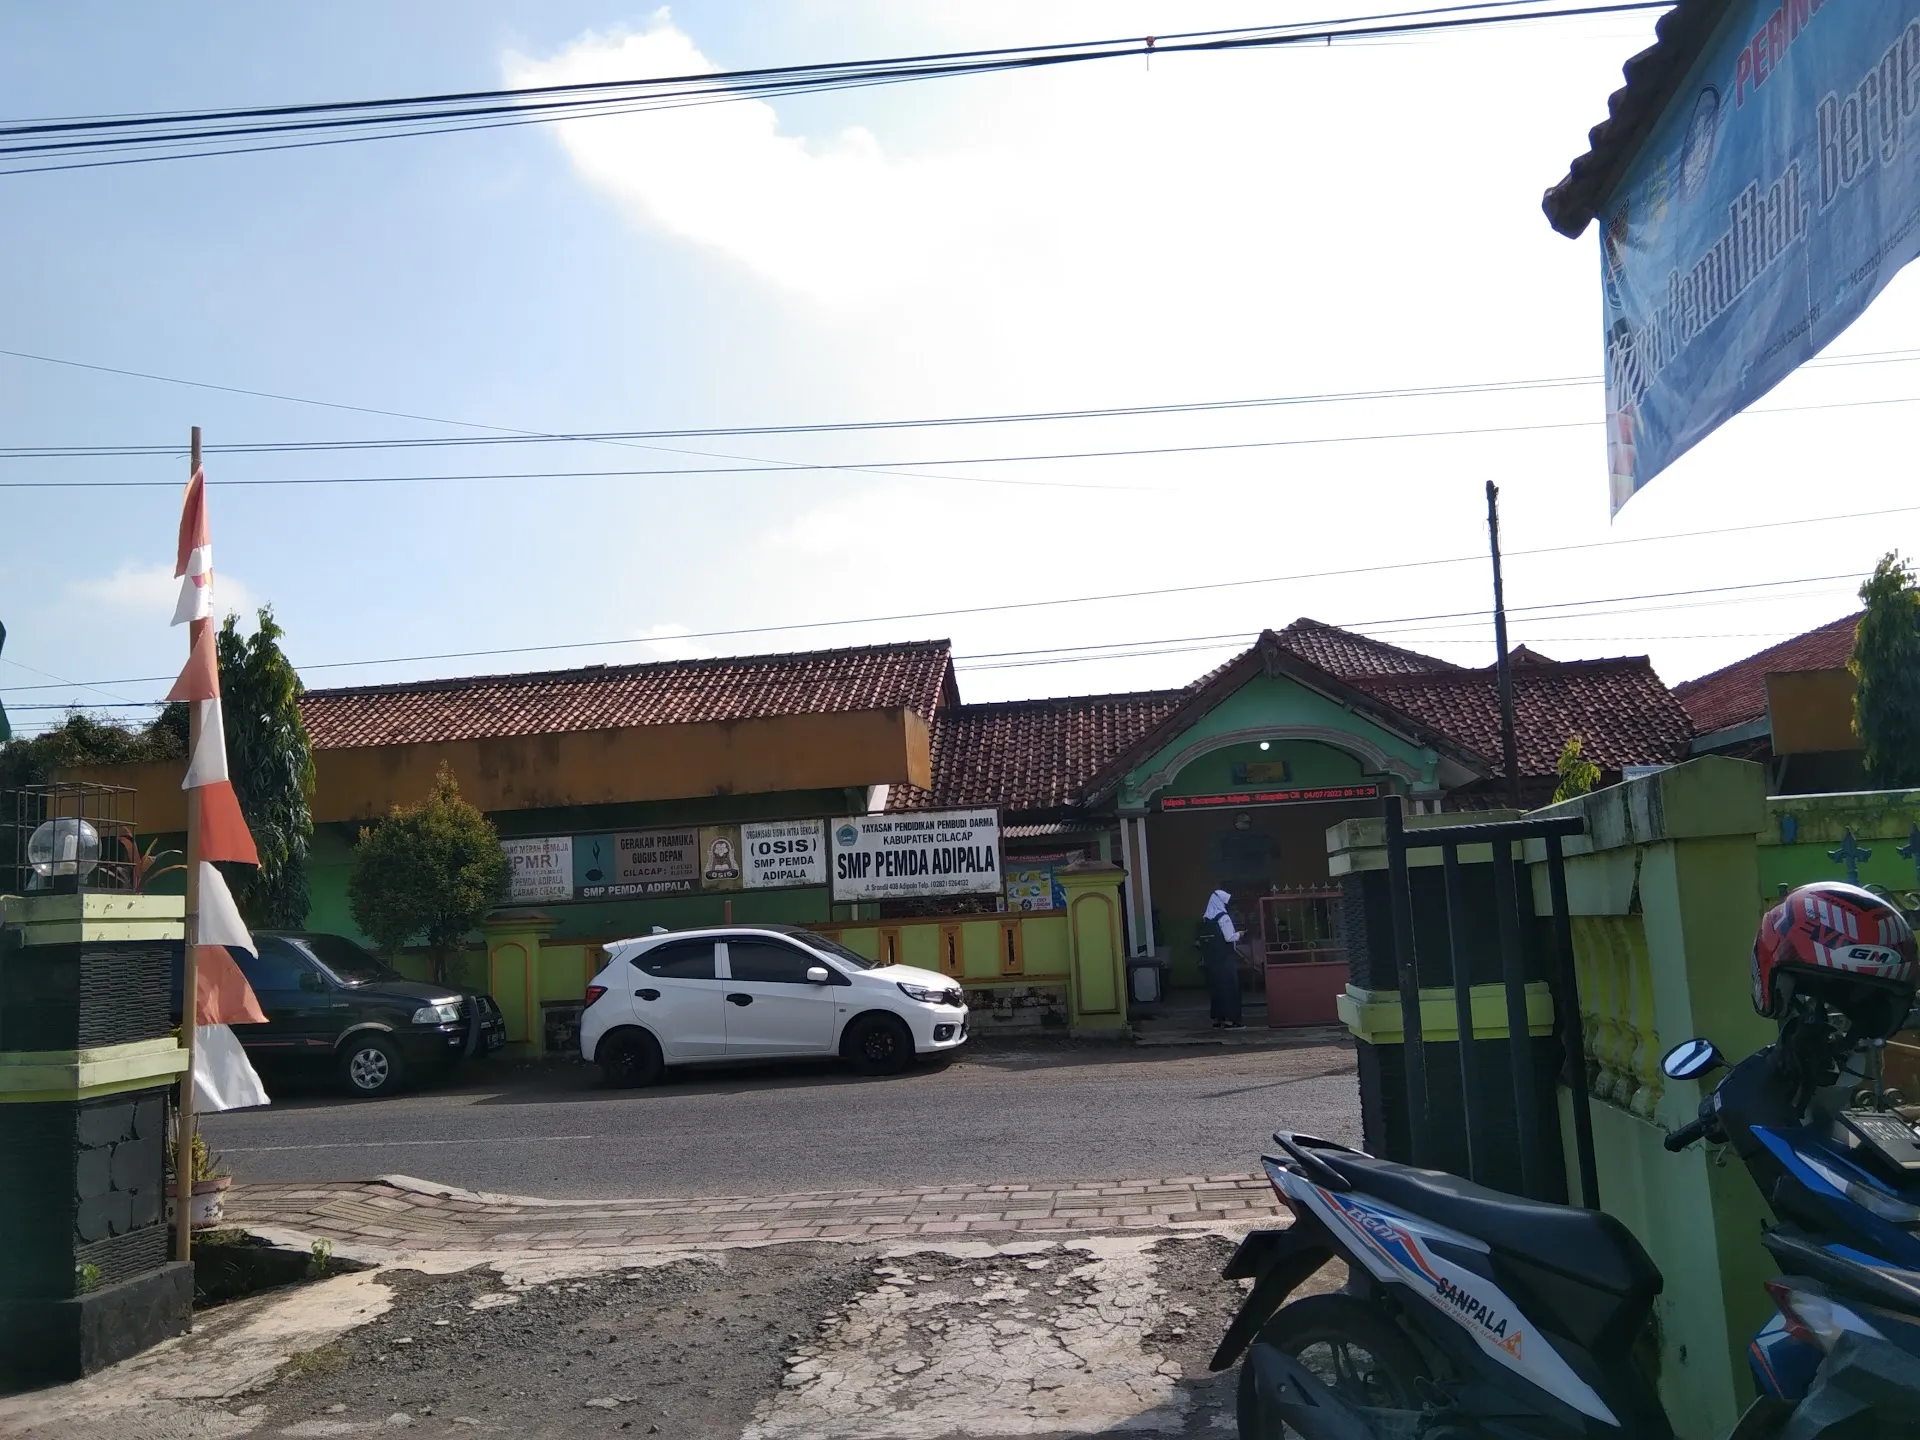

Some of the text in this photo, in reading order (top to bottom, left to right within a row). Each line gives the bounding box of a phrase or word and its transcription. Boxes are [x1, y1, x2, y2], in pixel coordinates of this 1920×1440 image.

[1736, 0, 1826, 111] PERIN
[861, 817, 994, 834] YAYASAN PENDIDIKAN PEMBUDI DARMA
[620, 834, 694, 850] GERAKAN PRAMUKA
[883, 831, 973, 846] KABUPATEN CILACAP
[513, 853, 558, 870] PMR)
[632, 850, 683, 864] GUGUS DEPAN
[754, 855, 814, 868] SMP PEMDA
[837, 845, 995, 880] SMP PEMDA ADIPALA
[711, 870, 733, 878] OSIS
[762, 869, 806, 880] ADIPALA
[583, 881, 691, 897] SMP PEMDA ADIPALA
[1848, 947, 1890, 964] GM
[1436, 1277, 1508, 1338] SANPALA
